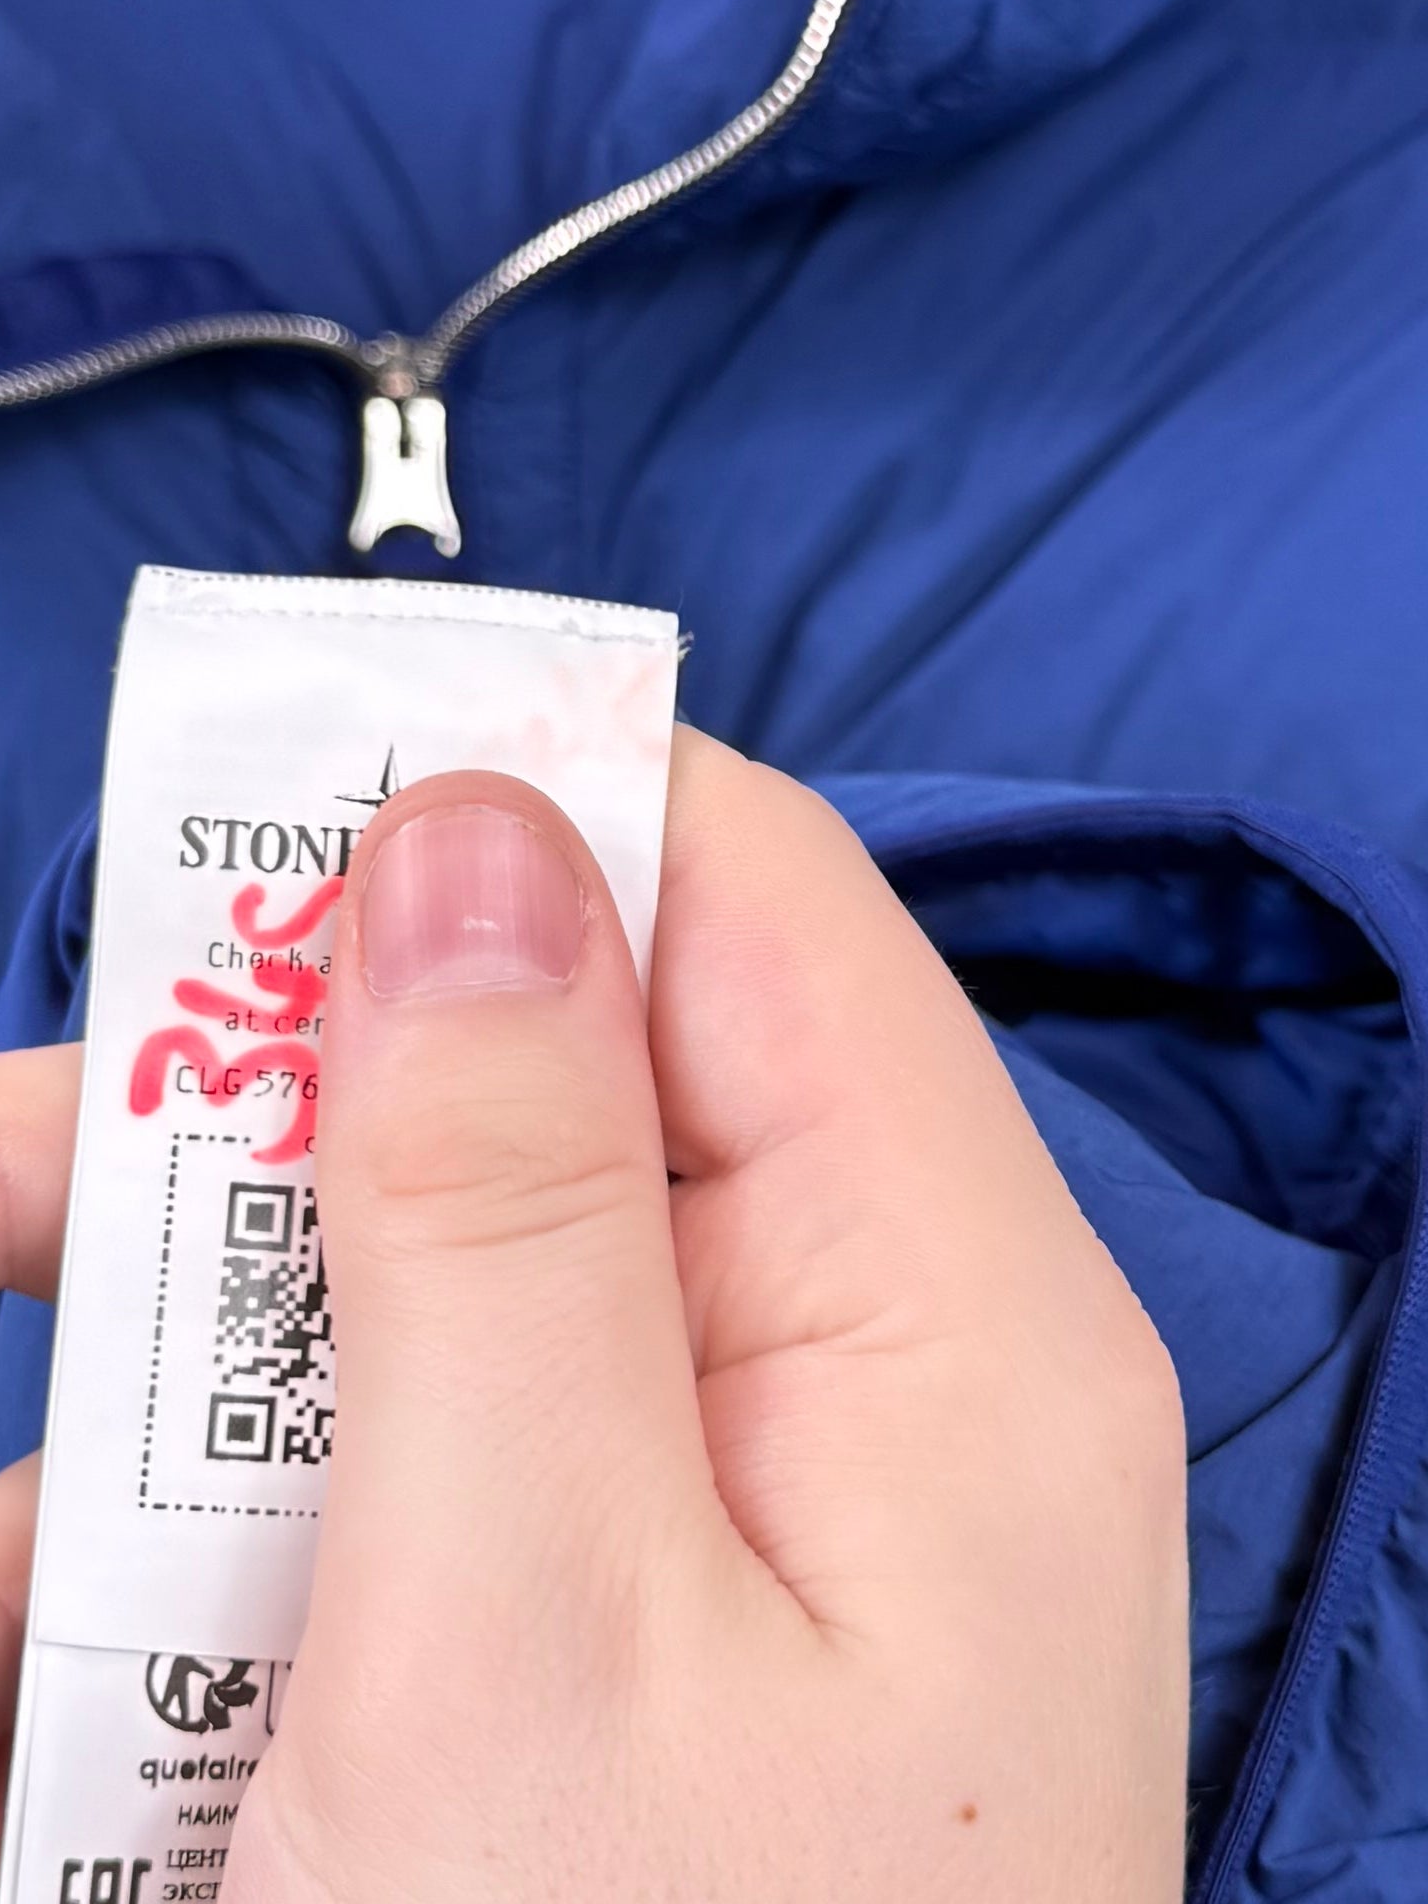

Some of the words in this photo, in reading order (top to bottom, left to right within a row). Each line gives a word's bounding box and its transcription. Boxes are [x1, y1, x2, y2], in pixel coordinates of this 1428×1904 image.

[225, 1009, 259, 1032] at
[176, 1065, 241, 1095] CLG
[253, 1069, 318, 1100] 576
